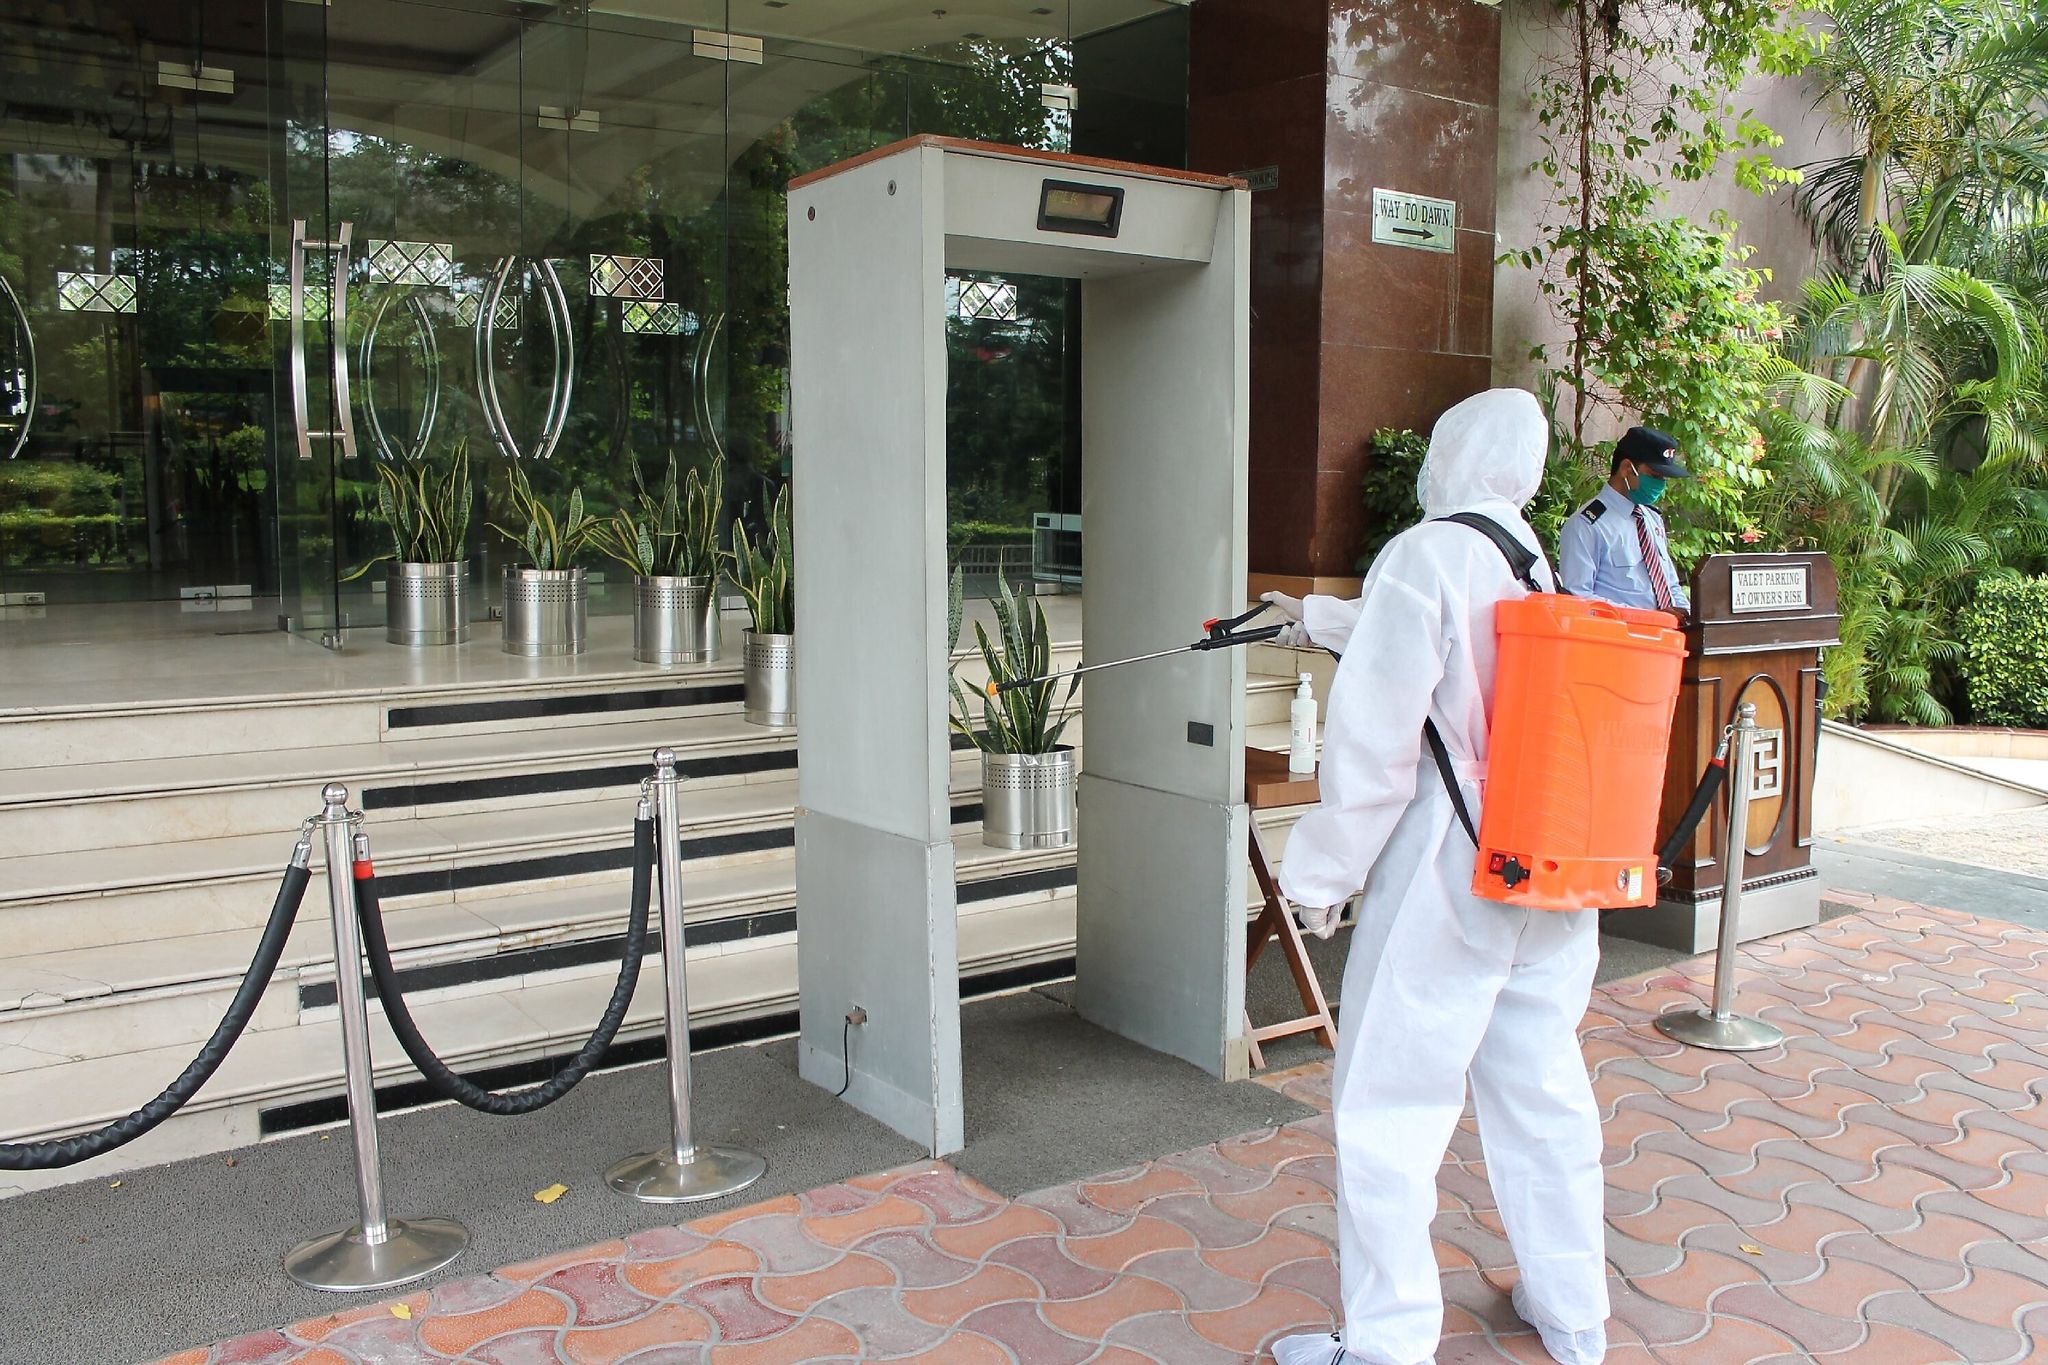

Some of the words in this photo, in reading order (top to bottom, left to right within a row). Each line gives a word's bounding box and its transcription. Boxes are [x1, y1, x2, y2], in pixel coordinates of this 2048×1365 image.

[1380, 199, 1401, 219] WAY
[1405, 203, 1418, 221] TO
[1421, 206, 1449, 226] DAWN
[1738, 573, 1763, 586] VALET
[1765, 572, 1799, 586] PARKING
[1736, 592, 1746, 605] AT
[1784, 590, 1802, 603] RISK
